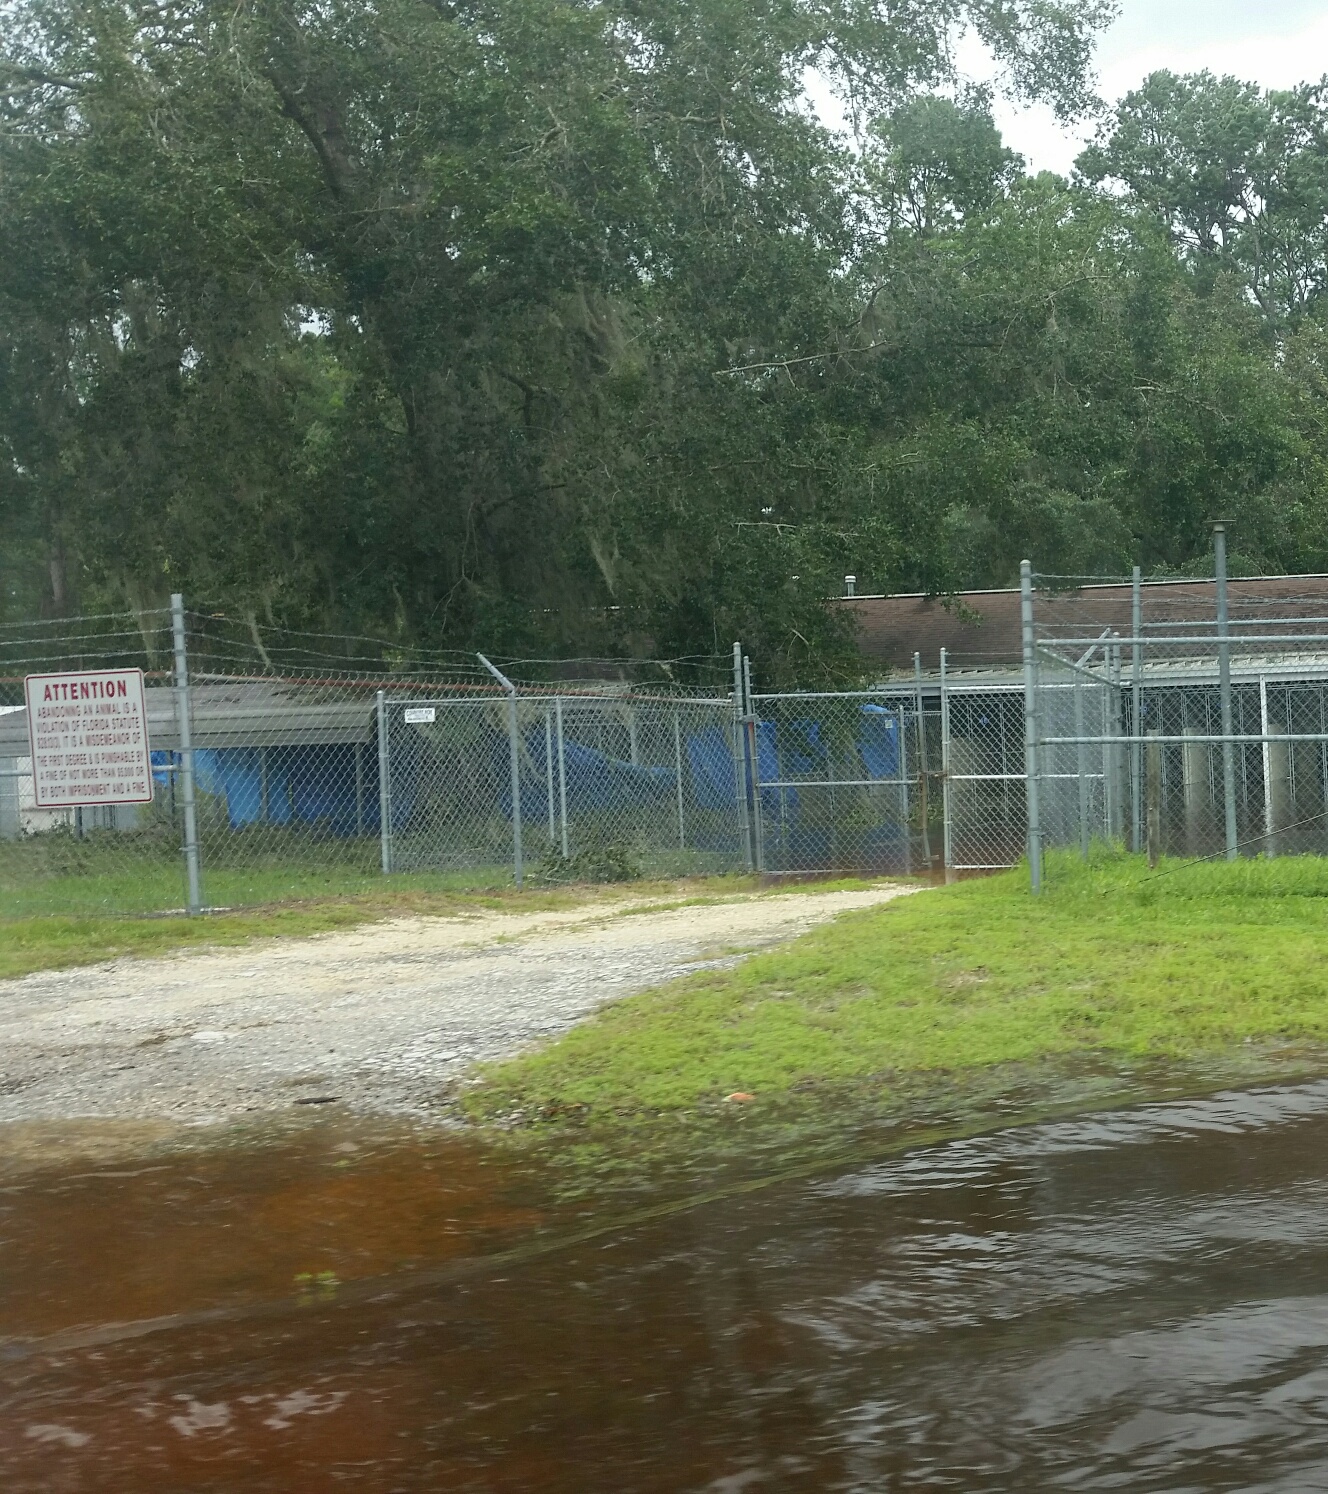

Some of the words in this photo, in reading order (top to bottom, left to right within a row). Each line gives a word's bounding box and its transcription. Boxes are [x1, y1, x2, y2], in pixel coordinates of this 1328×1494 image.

[44, 680, 127, 702] ATTENTION
[38, 705, 81, 719] ABANDONING
[84, 704, 93, 716] AN
[95, 703, 121, 716] ANIMAL
[123, 702, 130, 714] IS
[132, 702, 138, 713] A
[37, 721, 69, 734] VIOLATION
[72, 720, 80, 732] OF
[82, 718, 109, 732] FLORIDA
[112, 717, 140, 730] STATUTE
[63, 735, 69, 748] IT
[71, 735, 77, 747] IS
[79, 734, 84, 746] A
[86, 732, 130, 747] MISDEMEANOR
[133, 732, 141, 744] OF
[37, 756, 47, 767] THE
[49, 754, 63, 766] FIRST
[65, 753, 87, 766] DEGREE
[94, 752, 100, 765] IS
[102, 750, 135, 764] PUNISHABLE
[137, 750, 144, 763] BY
[40, 771, 44, 781] A
[46, 770, 58, 781] FINE
[60, 769, 67, 781] OF
[69, 768, 80, 780] NOT
[82, 767, 99, 780] MORE
[100, 767, 116, 779] THAN
[136, 765, 144, 777] OR
[41, 786, 48, 799] BY
[50, 784, 66, 799] BOTH
[68, 782, 110, 797] IMPRISONMENT
[113, 781, 125, 795] AND
[126, 781, 131, 793] A
